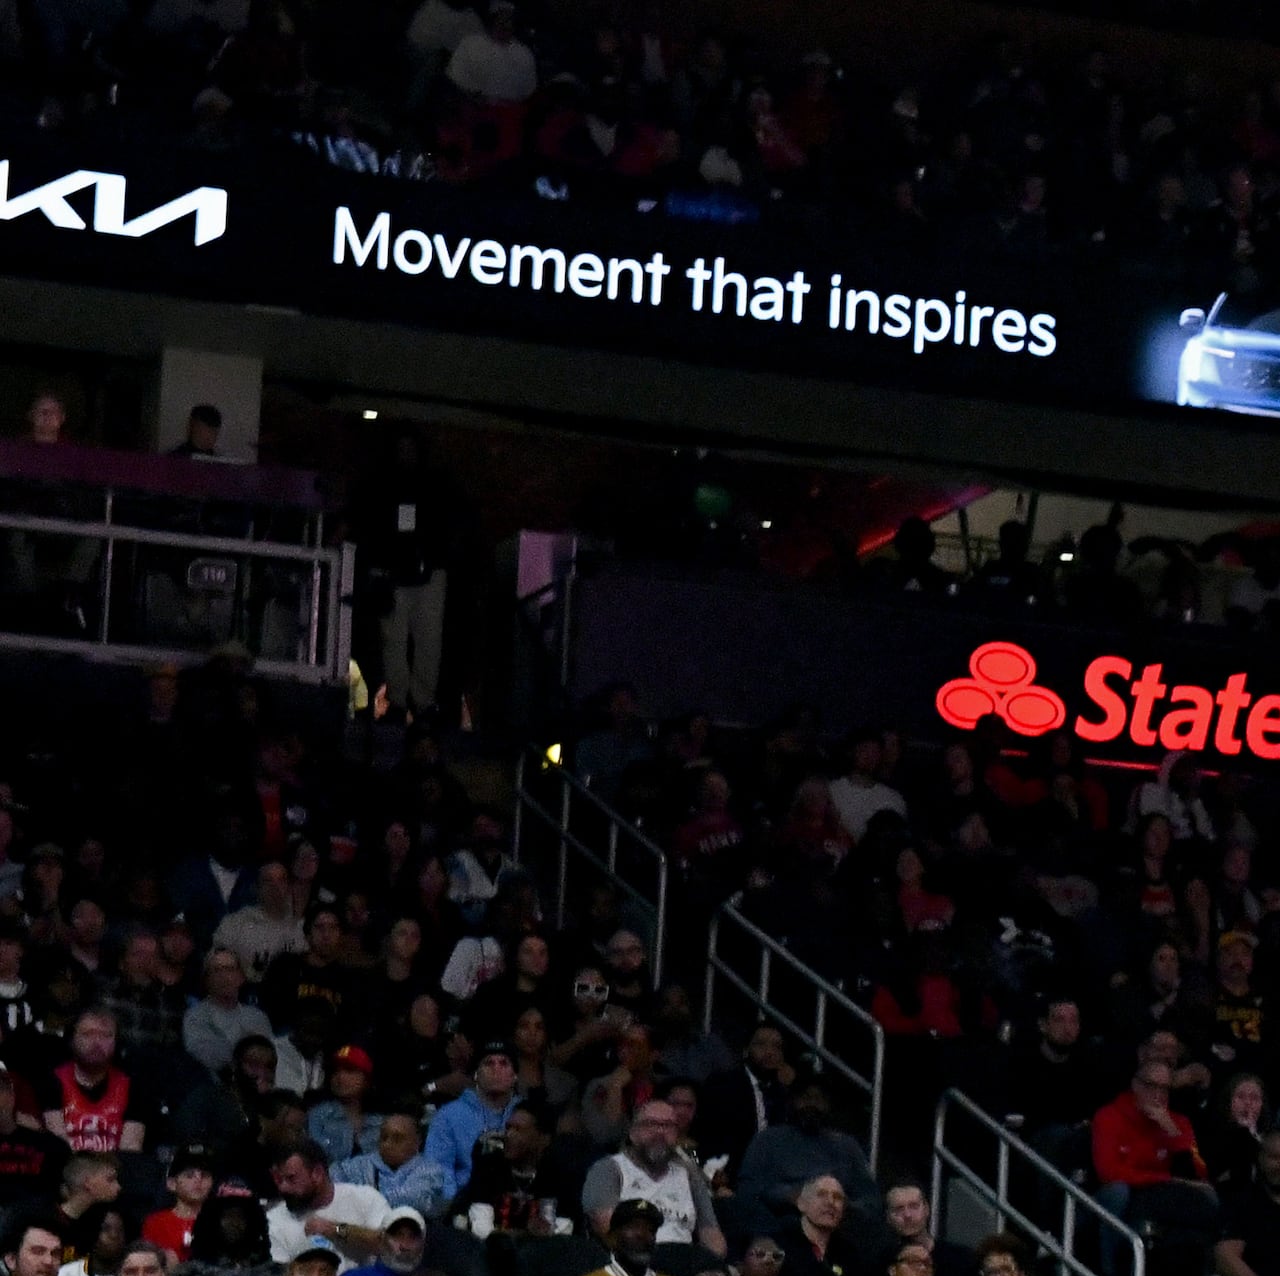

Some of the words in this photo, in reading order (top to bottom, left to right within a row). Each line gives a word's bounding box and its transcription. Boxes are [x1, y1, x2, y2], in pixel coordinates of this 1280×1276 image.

[333, 206, 671, 307] Movement
[685, 257, 812, 325] that
[828, 273, 1058, 359] inspires
